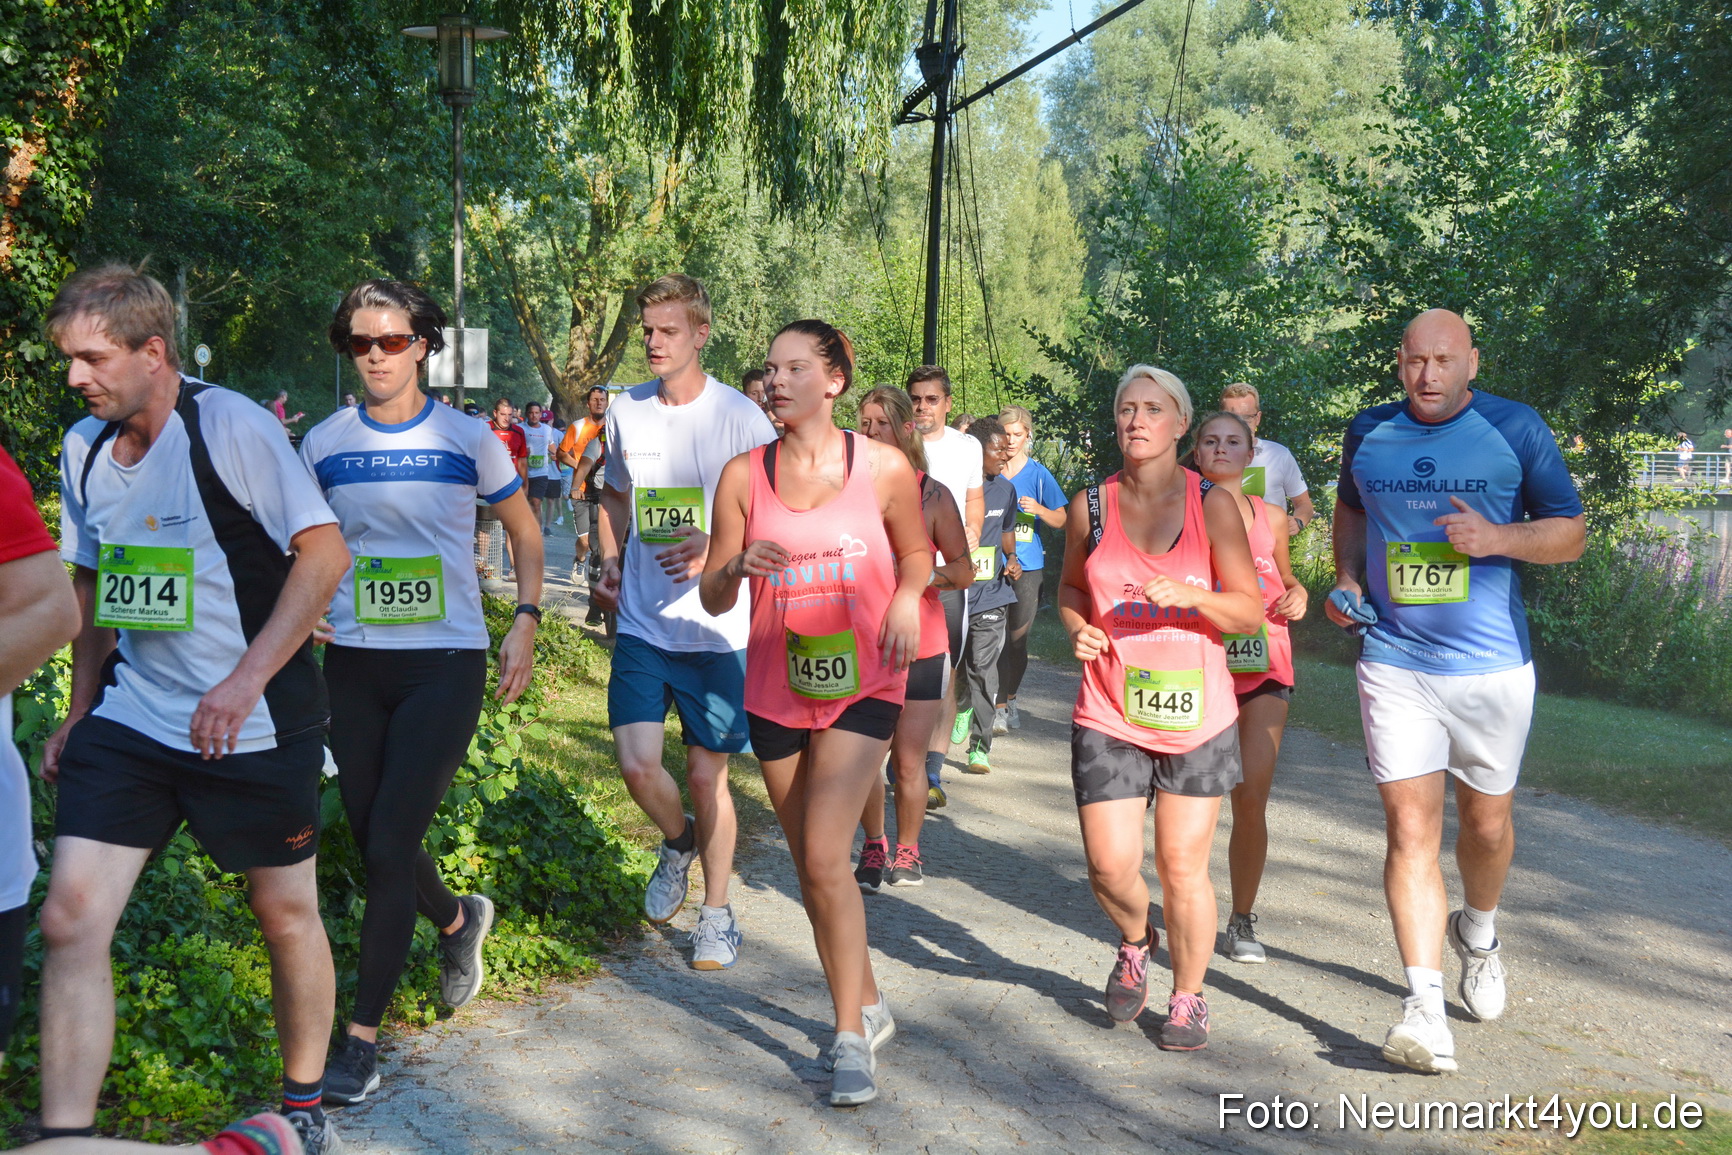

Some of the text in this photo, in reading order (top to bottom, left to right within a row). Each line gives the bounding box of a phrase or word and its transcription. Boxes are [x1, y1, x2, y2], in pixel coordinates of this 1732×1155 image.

[341, 455, 443, 469] TR PLAST
[1366, 478, 1488, 493] SCHABMÜLLER
[1088, 487, 1100, 517] SURF
[1406, 500, 1437, 510] TEAM
[645, 507, 695, 527] 1794
[822, 547, 844, 558] mit
[768, 562, 856, 587] NOVITA
[1395, 564, 1458, 586] 1767
[104, 574, 179, 607] 2014
[365, 580, 432, 605] 1959
[773, 583, 856, 599] Seniorenzentrm
[1123, 583, 1147, 600] Pfle
[110, 605, 169, 616] Scherer Markus
[391, 605, 418, 613] Claudia
[1113, 599, 1199, 618] NOVITA
[1113, 617, 1200, 631] Seniorenzentrum
[1112, 630, 1200, 644] Postbauer-Heng
[1226, 639, 1263, 658] 449
[791, 654, 847, 682] 1450
[798, 679, 839, 689] Kurth Jessica
[1134, 688, 1193, 713] 1448
[1137, 709, 1162, 718] Wächter
